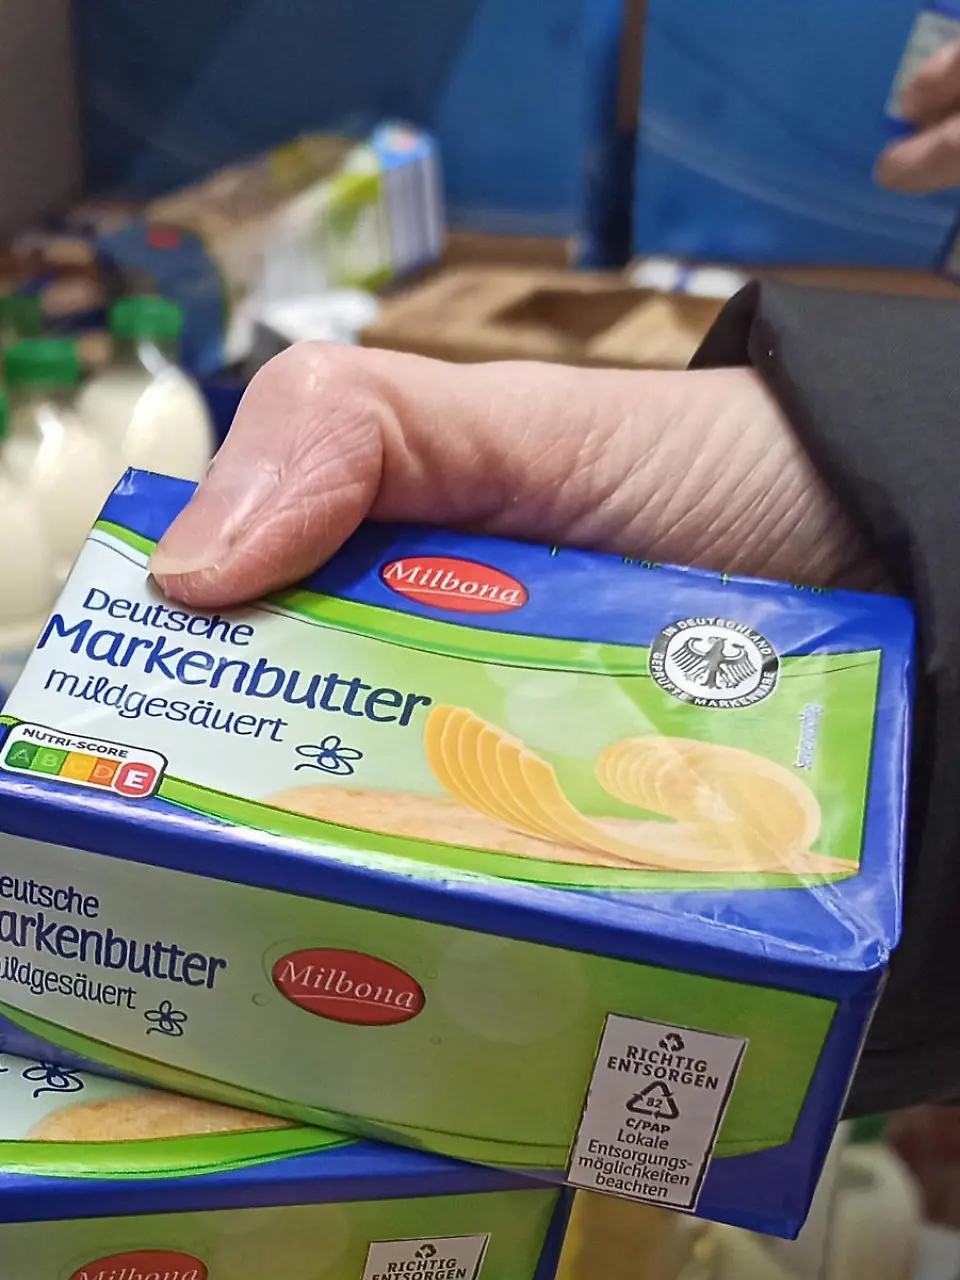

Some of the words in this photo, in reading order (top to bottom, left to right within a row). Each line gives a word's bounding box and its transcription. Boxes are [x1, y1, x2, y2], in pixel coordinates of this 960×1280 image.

[384, 561, 522, 605] Milbona
[82, 587, 254, 647] Deutsche
[37, 613, 432, 727] Markenbutter
[45, 667, 288, 742] mildgesäuert
[22, 728, 129, 758] NUTRI-SCORE
[123, 770, 149, 789] E
[278, 960, 416, 1009] Milbona
[607, 1056, 719, 1090] ENTSORGEN
[626, 1045, 707, 1073] RICHTIG
[646, 1097, 663, 1109] 82
[617, 1129, 669, 1150] Lokale
[625, 1118, 671, 1134] C/PAP
[587, 1139, 693, 1171] Entsorgungs-
[578, 1156, 690, 1186] möglichkeiten
[595, 1173, 669, 1198] beachten
[387, 1258, 457, 1273] RICHTIG
